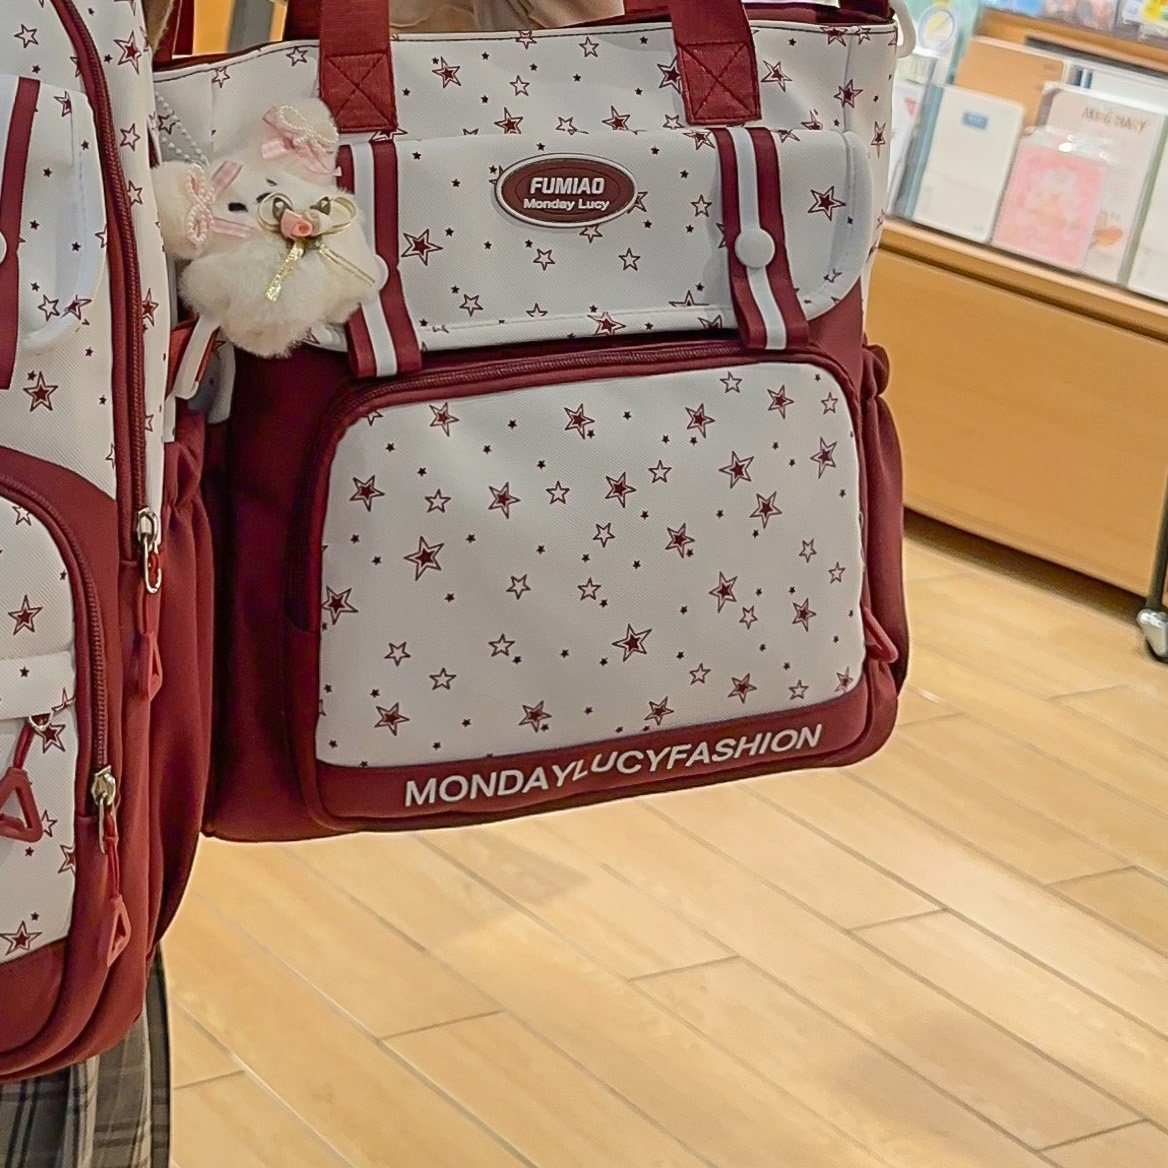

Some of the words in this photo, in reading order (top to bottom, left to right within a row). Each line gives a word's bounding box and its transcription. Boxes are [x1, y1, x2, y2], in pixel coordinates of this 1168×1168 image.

[530, 177, 605, 195] FUMIAO
[523, 198, 576, 211] Monday
[578, 198, 610, 211] Lucy
[404, 723, 823, 808] MONDAYLUCYFASHION
